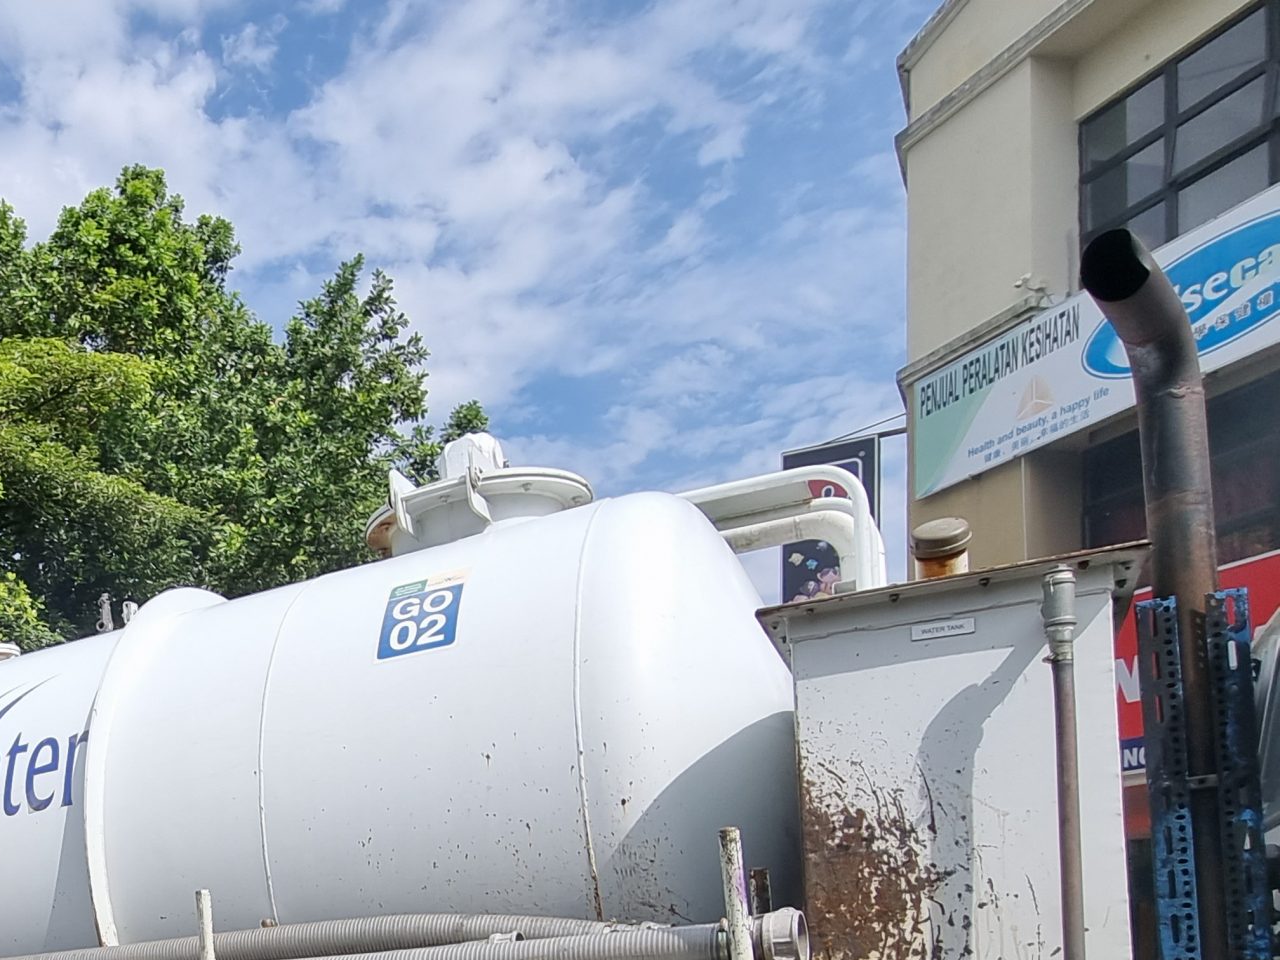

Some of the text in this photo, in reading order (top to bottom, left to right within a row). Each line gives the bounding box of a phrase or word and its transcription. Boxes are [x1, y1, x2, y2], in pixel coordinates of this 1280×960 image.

[920, 304, 1080, 420] PENJUAL PERALATAN KESIHATAN
[968, 439, 995, 458] Health
[997, 429, 1014, 445] and
[1051, 411, 1058, 419] a
[1060, 396, 1091, 416] happy
[1093, 387, 1110, 401] life
[392, 590, 453, 620] GO
[389, 613, 447, 650] 02
[921, 624, 966, 635] WATER TANK
